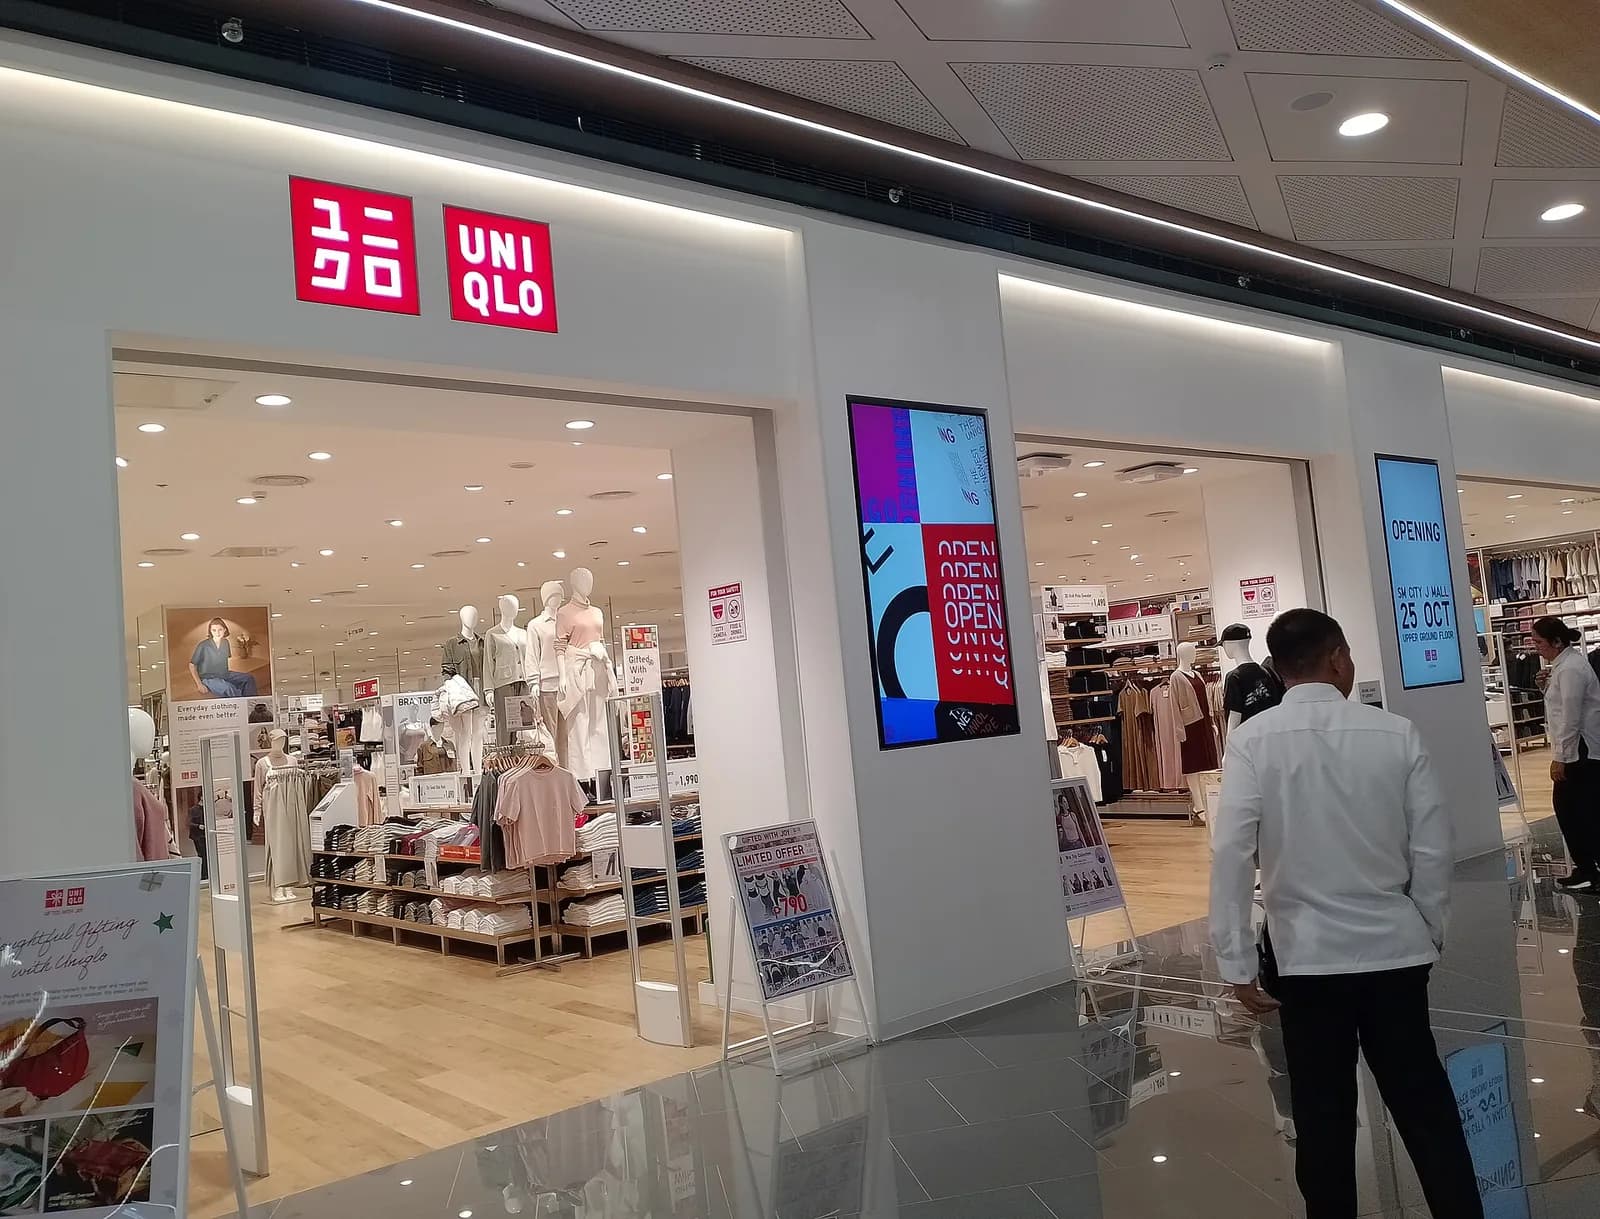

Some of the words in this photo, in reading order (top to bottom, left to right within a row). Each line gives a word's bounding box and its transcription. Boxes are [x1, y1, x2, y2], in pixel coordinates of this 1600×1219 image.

[311, 197, 399, 250] ユニ
[458, 224, 534, 273] UNI
[311, 247, 403, 298] クロ
[463, 270, 544, 317] QLO
[1391, 519, 1441, 542] OPENING
[1397, 587, 1407, 599] SM
[1408, 587, 1422, 598] CITY
[1425, 586, 1429, 597] J
[1431, 586, 1449, 598] MALL
[945, 601, 1003, 629] OPEN
[1400, 602, 1417, 629] 25
[1424, 601, 1450, 628] OCT
[1402, 632, 1419, 643] UPPER
[1420, 631, 1438, 642] GROUND
[1439, 630, 1454, 640] FLOOR
[628, 655, 650, 665] Gifted
[630, 664, 648, 674] With
[630, 675, 644, 686] Joy
[355, 685, 367, 698] SALE
[419, 696, 434, 704] TOP
[177, 704, 209, 714] Everyday
[177, 713, 197, 722] made
[198, 712, 214, 720] even
[741, 835, 762, 844] GIFTED
[763, 831, 779, 840] WITH
[780, 829, 790, 837] JOY
[736, 851, 773, 867] LIMITED
[775, 844, 805, 859] OFFER
[73, 916, 140, 951] Gifting
[11, 957, 54, 979] with
[54, 946, 109, 981] Uniqlo
